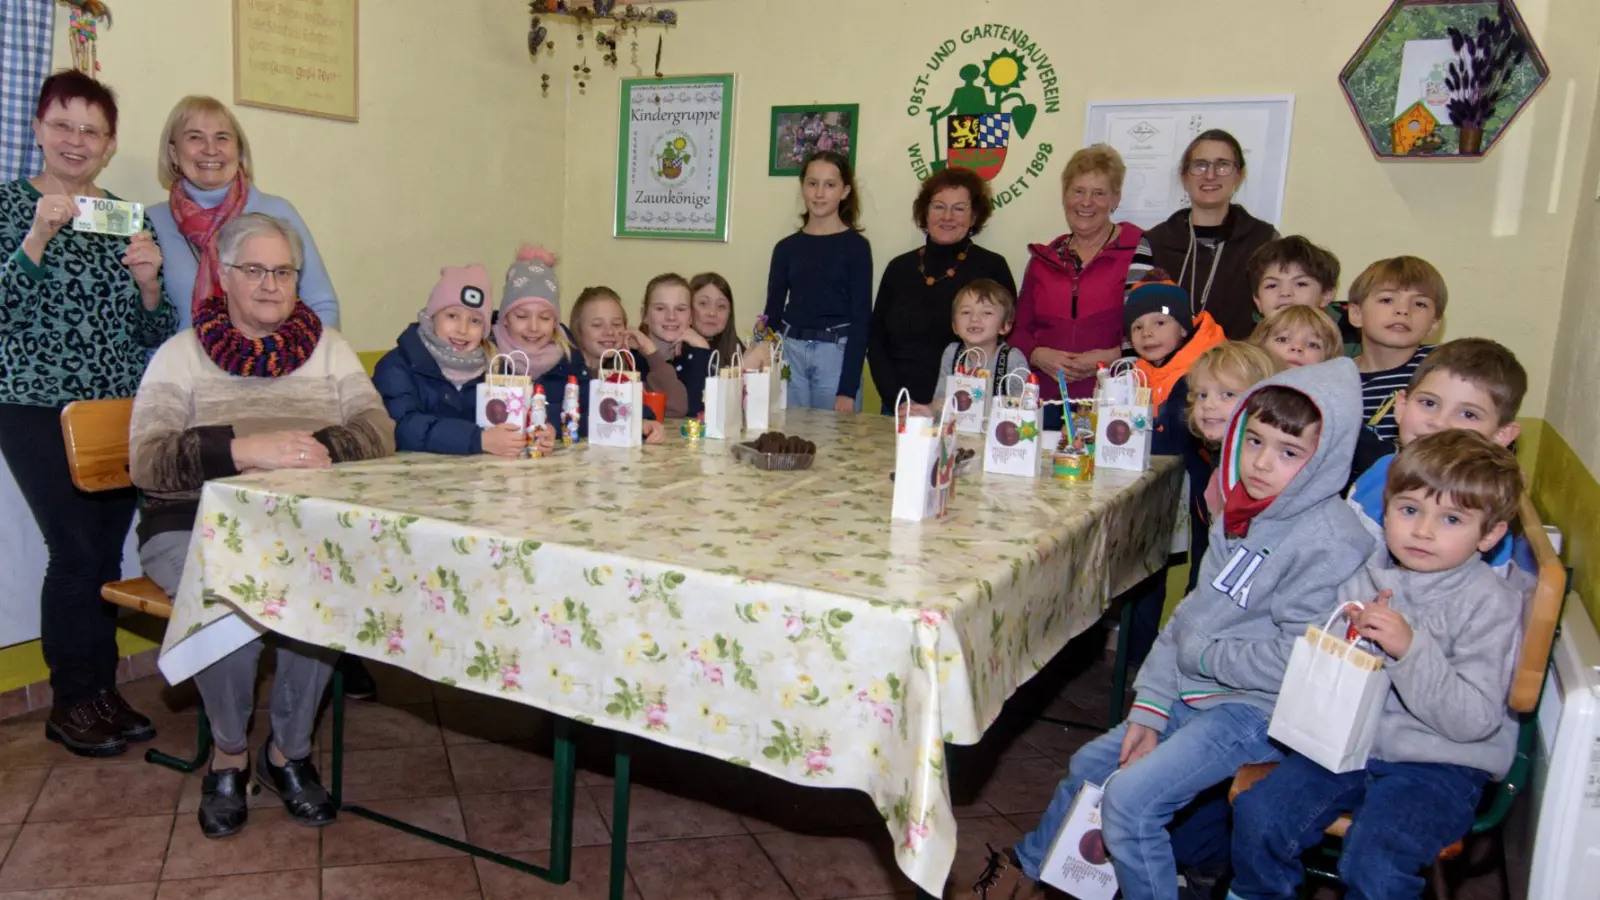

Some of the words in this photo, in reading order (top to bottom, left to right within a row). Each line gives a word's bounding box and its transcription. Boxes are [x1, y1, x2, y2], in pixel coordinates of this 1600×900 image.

[907, 73, 930, 117] OBST-
[926, 39, 957, 71] UND
[960, 24, 1060, 114] GARTENBAUVEREIN
[631, 107, 720, 125] Kindergruppe
[907, 143, 930, 182] WEID
[1026, 142, 1054, 178] 1898
[92, 200, 114, 211] 100
[635, 189, 711, 209] Zaunkönige
